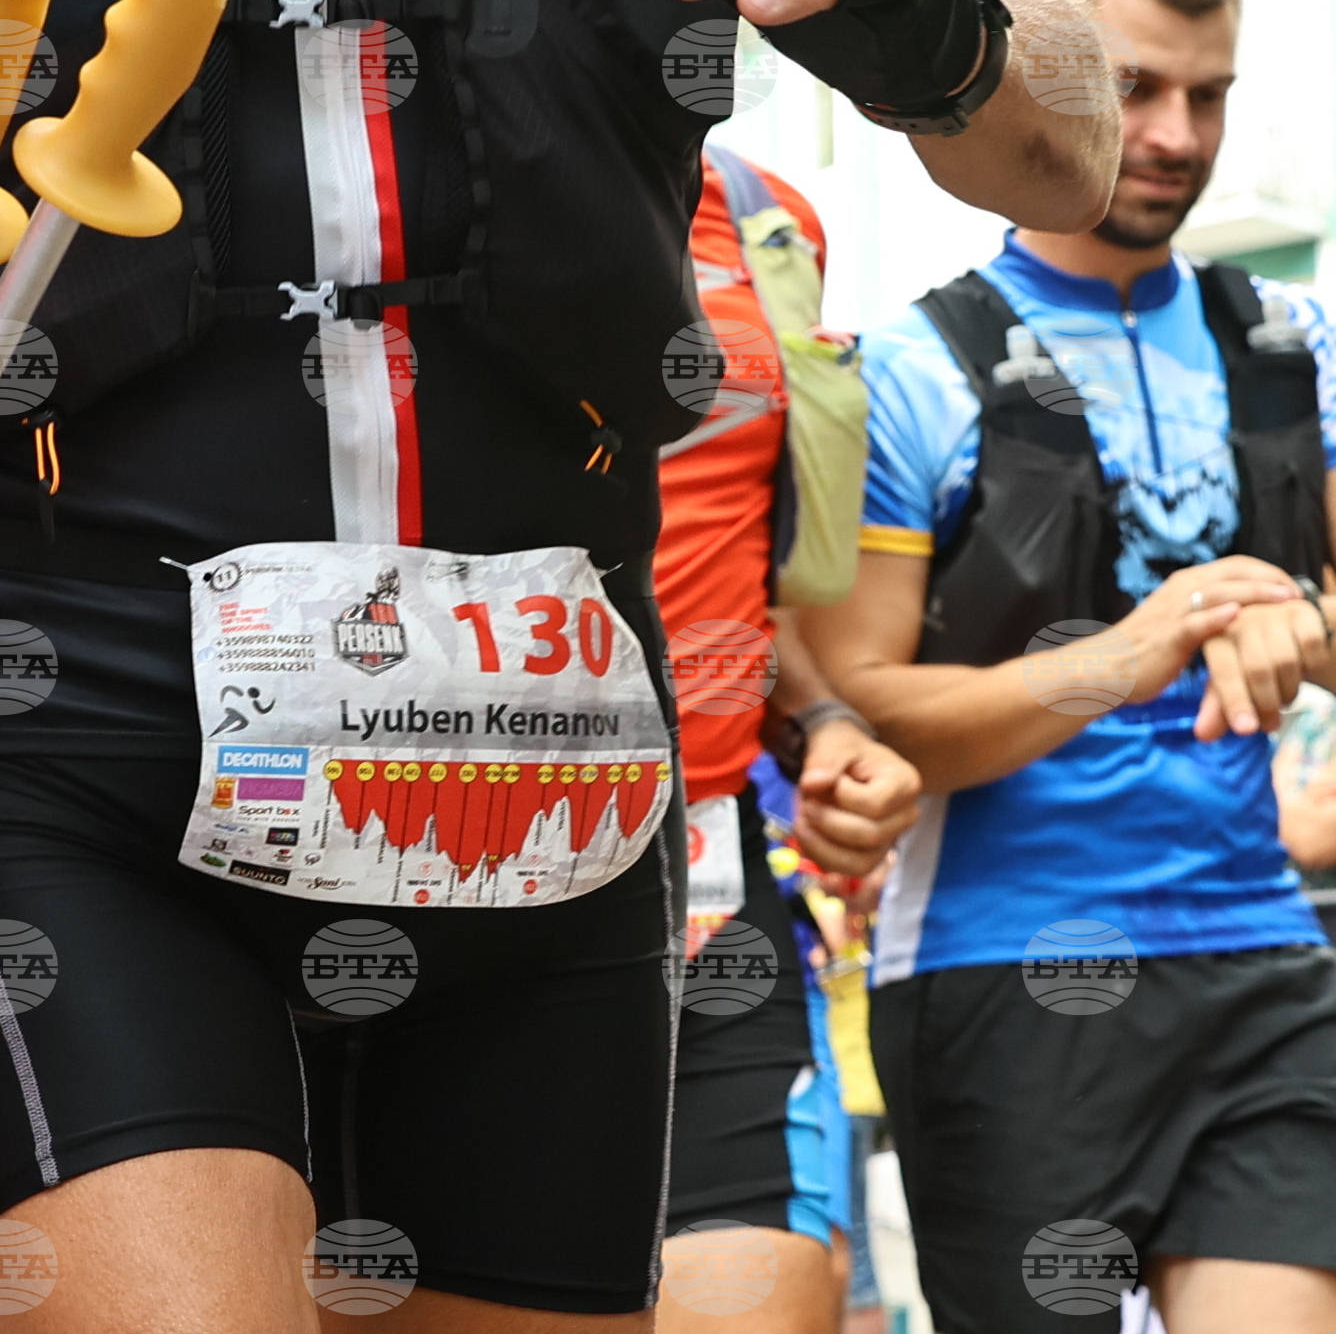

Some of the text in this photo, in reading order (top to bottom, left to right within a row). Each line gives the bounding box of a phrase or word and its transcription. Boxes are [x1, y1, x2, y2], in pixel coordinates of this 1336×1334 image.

[337, 623, 404, 653] PERSENK
[452, 595, 613, 678] 130
[340, 699, 619, 741] Lyuben Kenanov
[222, 752, 304, 769] DECATHLON
[238, 805, 274, 816] Sport
[232, 866, 286, 885] SUUNTO
